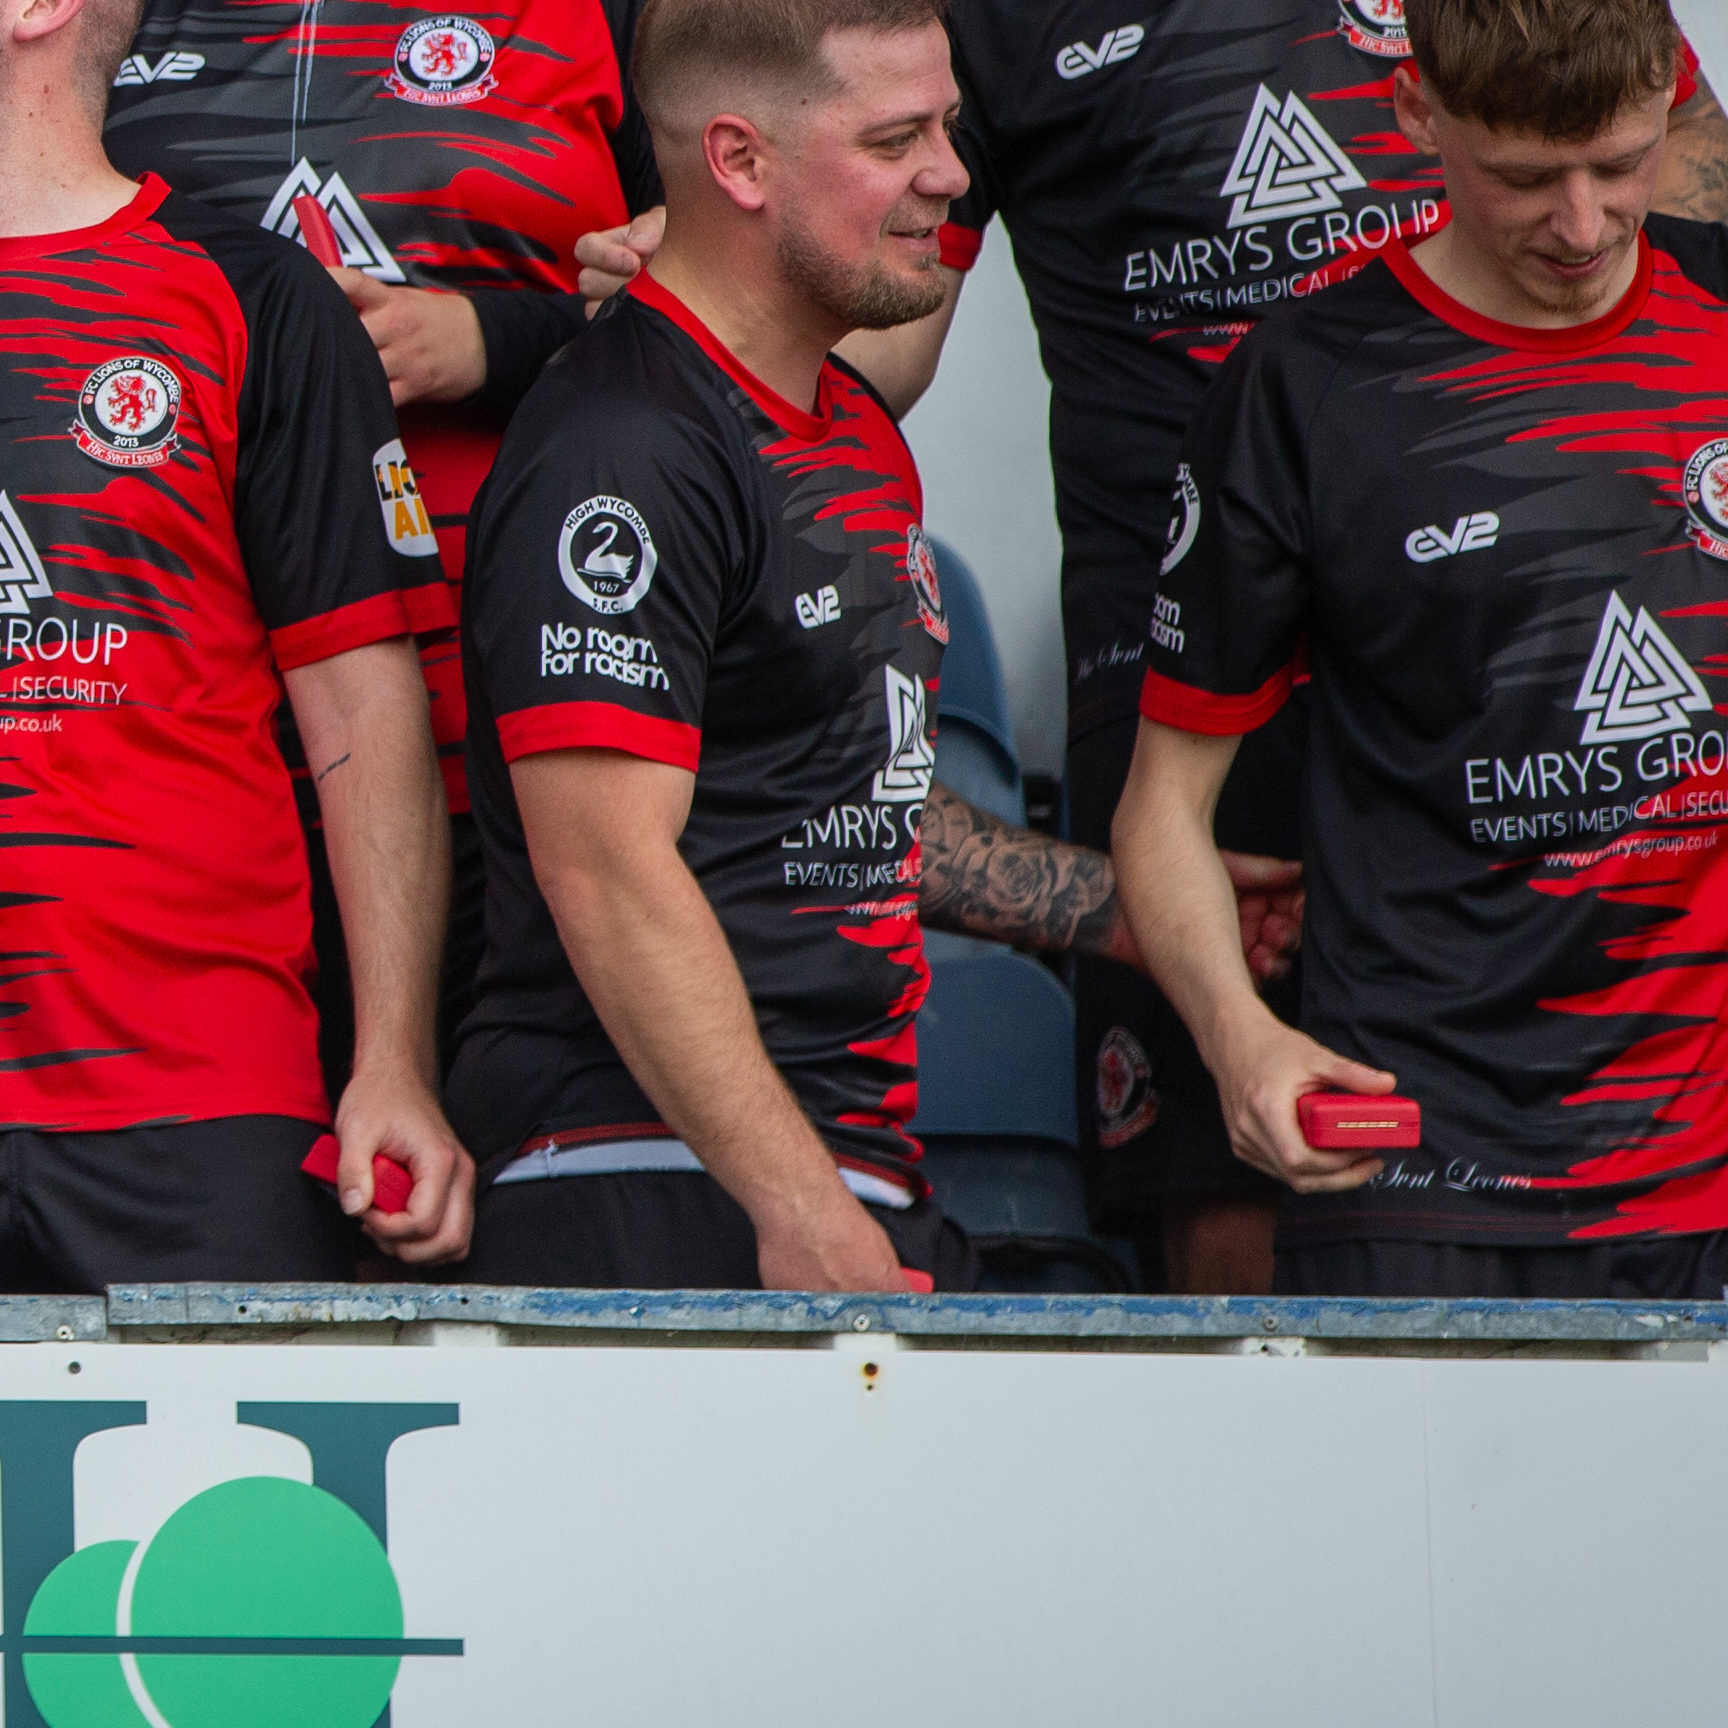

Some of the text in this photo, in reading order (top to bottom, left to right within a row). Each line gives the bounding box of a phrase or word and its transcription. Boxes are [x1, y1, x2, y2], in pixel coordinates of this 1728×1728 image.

[1124, 198, 1440, 292] EMRYS GROUP
[85, 359, 180, 403] FC LIONS OF WYCOMBE
[113, 435, 139, 447] 2013
[375, 459, 419, 501] LIO
[395, 498, 430, 540] AI
[565, 497, 650, 545] HIGH WYCOMBE
[592, 598, 623, 613] S.F.C.
[593, 581, 619, 593] 1967
[541, 622, 658, 663] No room
[541, 649, 670, 690] for racism
[19, 676, 128, 705] SECURITY
[1465, 730, 1728, 804] EMRYS GRO
[1578, 794, 1677, 833] MEDICAL
